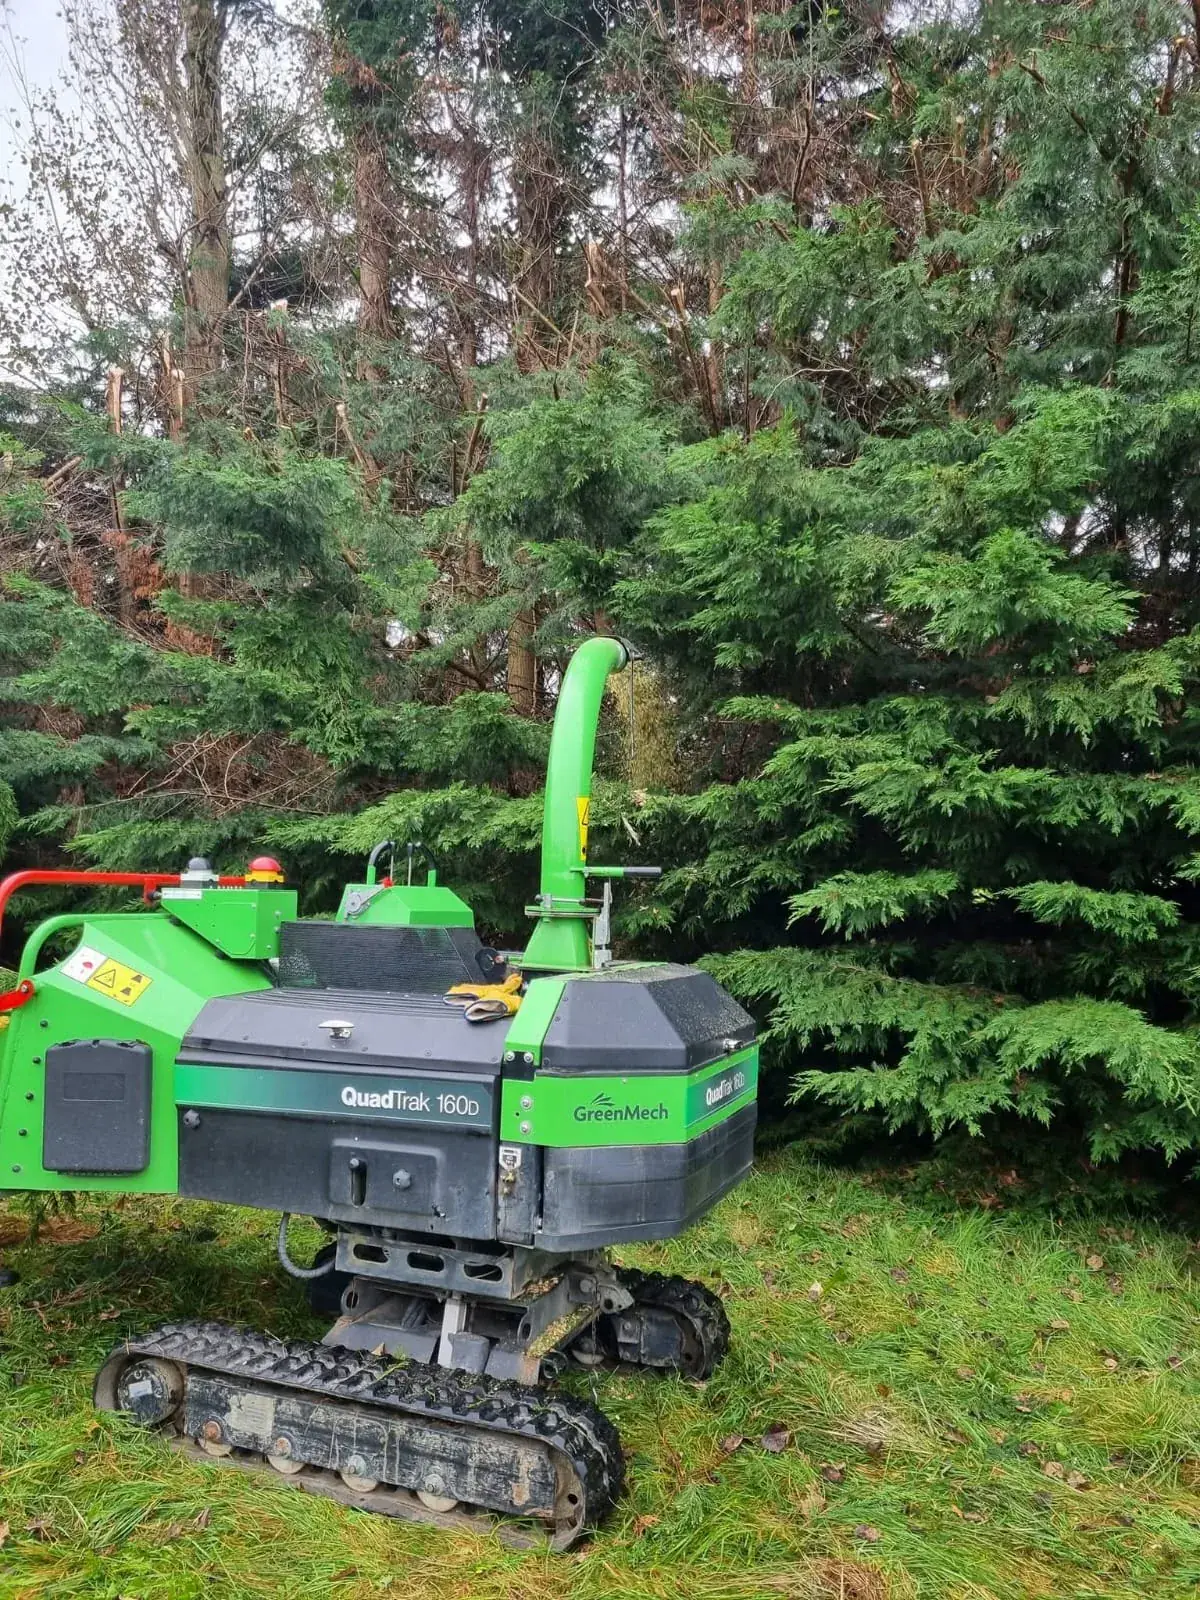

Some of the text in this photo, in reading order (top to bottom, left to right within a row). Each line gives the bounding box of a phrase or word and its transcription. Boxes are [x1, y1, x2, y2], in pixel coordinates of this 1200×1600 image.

[341, 1086, 479, 1116] QuadTrak 160D
[706, 1078, 733, 1105] QuadTrak
[573, 1102, 669, 1122] GreenMech
